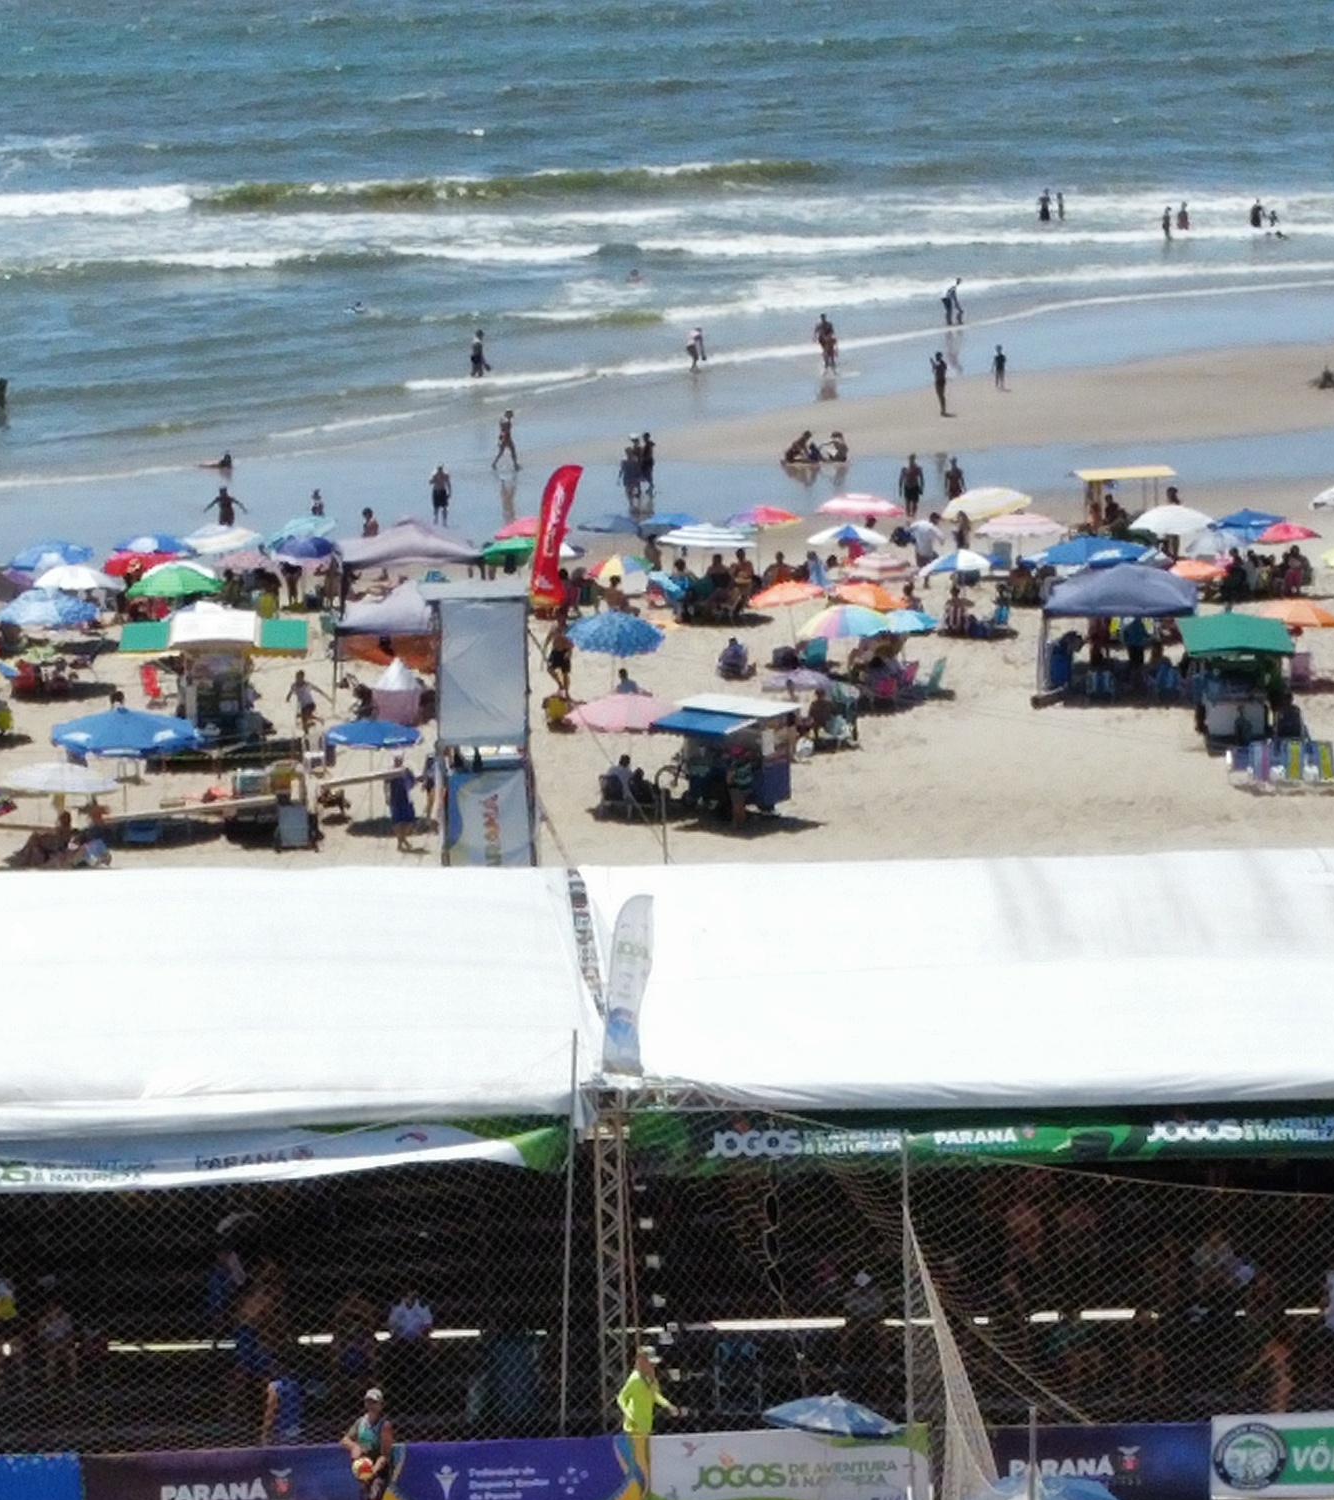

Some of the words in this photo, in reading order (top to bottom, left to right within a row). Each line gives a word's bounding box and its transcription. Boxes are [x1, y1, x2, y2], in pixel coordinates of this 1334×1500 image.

[705, 1127, 803, 1158] JOGOS
[934, 1126, 1019, 1145] PARANÁ
[1147, 1117, 1244, 1142] JOGOS
[691, 1463, 788, 1492] JOGOS
[789, 1463, 808, 1474] DE
[813, 1460, 898, 1474] AVENTURA
